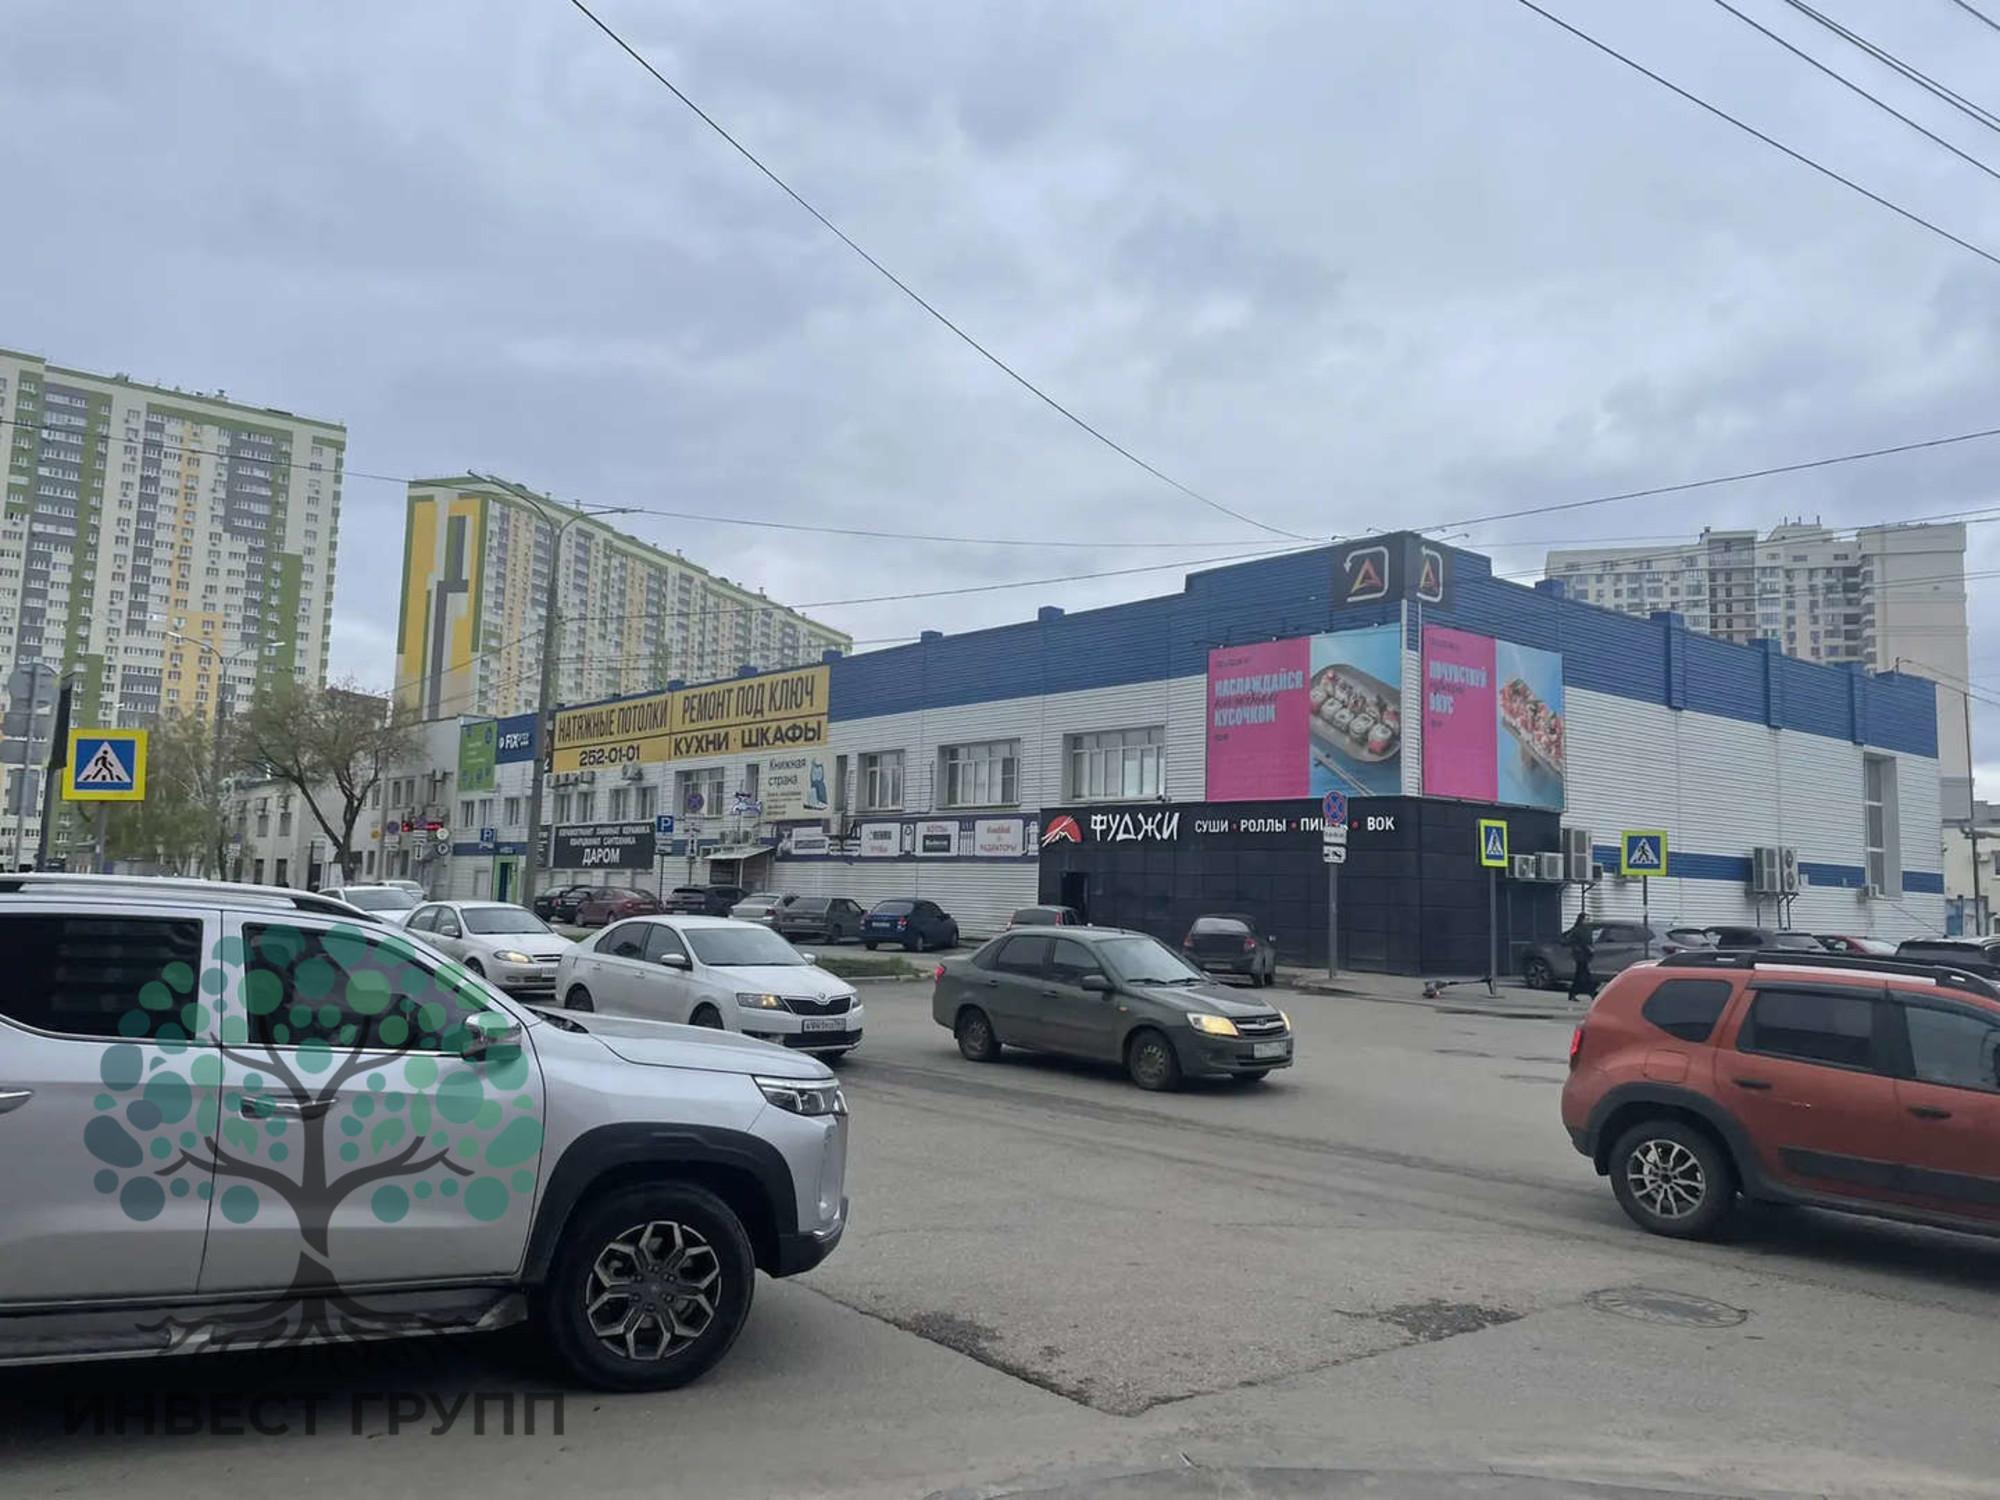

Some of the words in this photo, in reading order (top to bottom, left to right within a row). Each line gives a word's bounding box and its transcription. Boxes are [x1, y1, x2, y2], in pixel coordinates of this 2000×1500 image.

[1215, 668, 1304, 697] НАСЛАЖДАЙСЯ
[682, 686, 734, 725] РЕМОНТ
[735, 682, 765, 718] ПОД
[768, 675, 815, 712] КЛЮЧ
[558, 709, 615, 743] НАТЯЖНЫЕ
[617, 699, 668, 735] ПОТОЛКИ
[1214, 704, 1277, 728] КУСОЧКОМ
[673, 732, 729, 756] КУХНИ
[741, 720, 821, 748] ШКАФЫ
[1091, 812, 1181, 842] ФУДЖИ
[1195, 820, 1229, 833] СУШИ
[1240, 819, 1287, 833] РОЛЛЫ
[1367, 817, 1395, 831] ВОК
[582, 848, 620, 866] ДАРОМ
